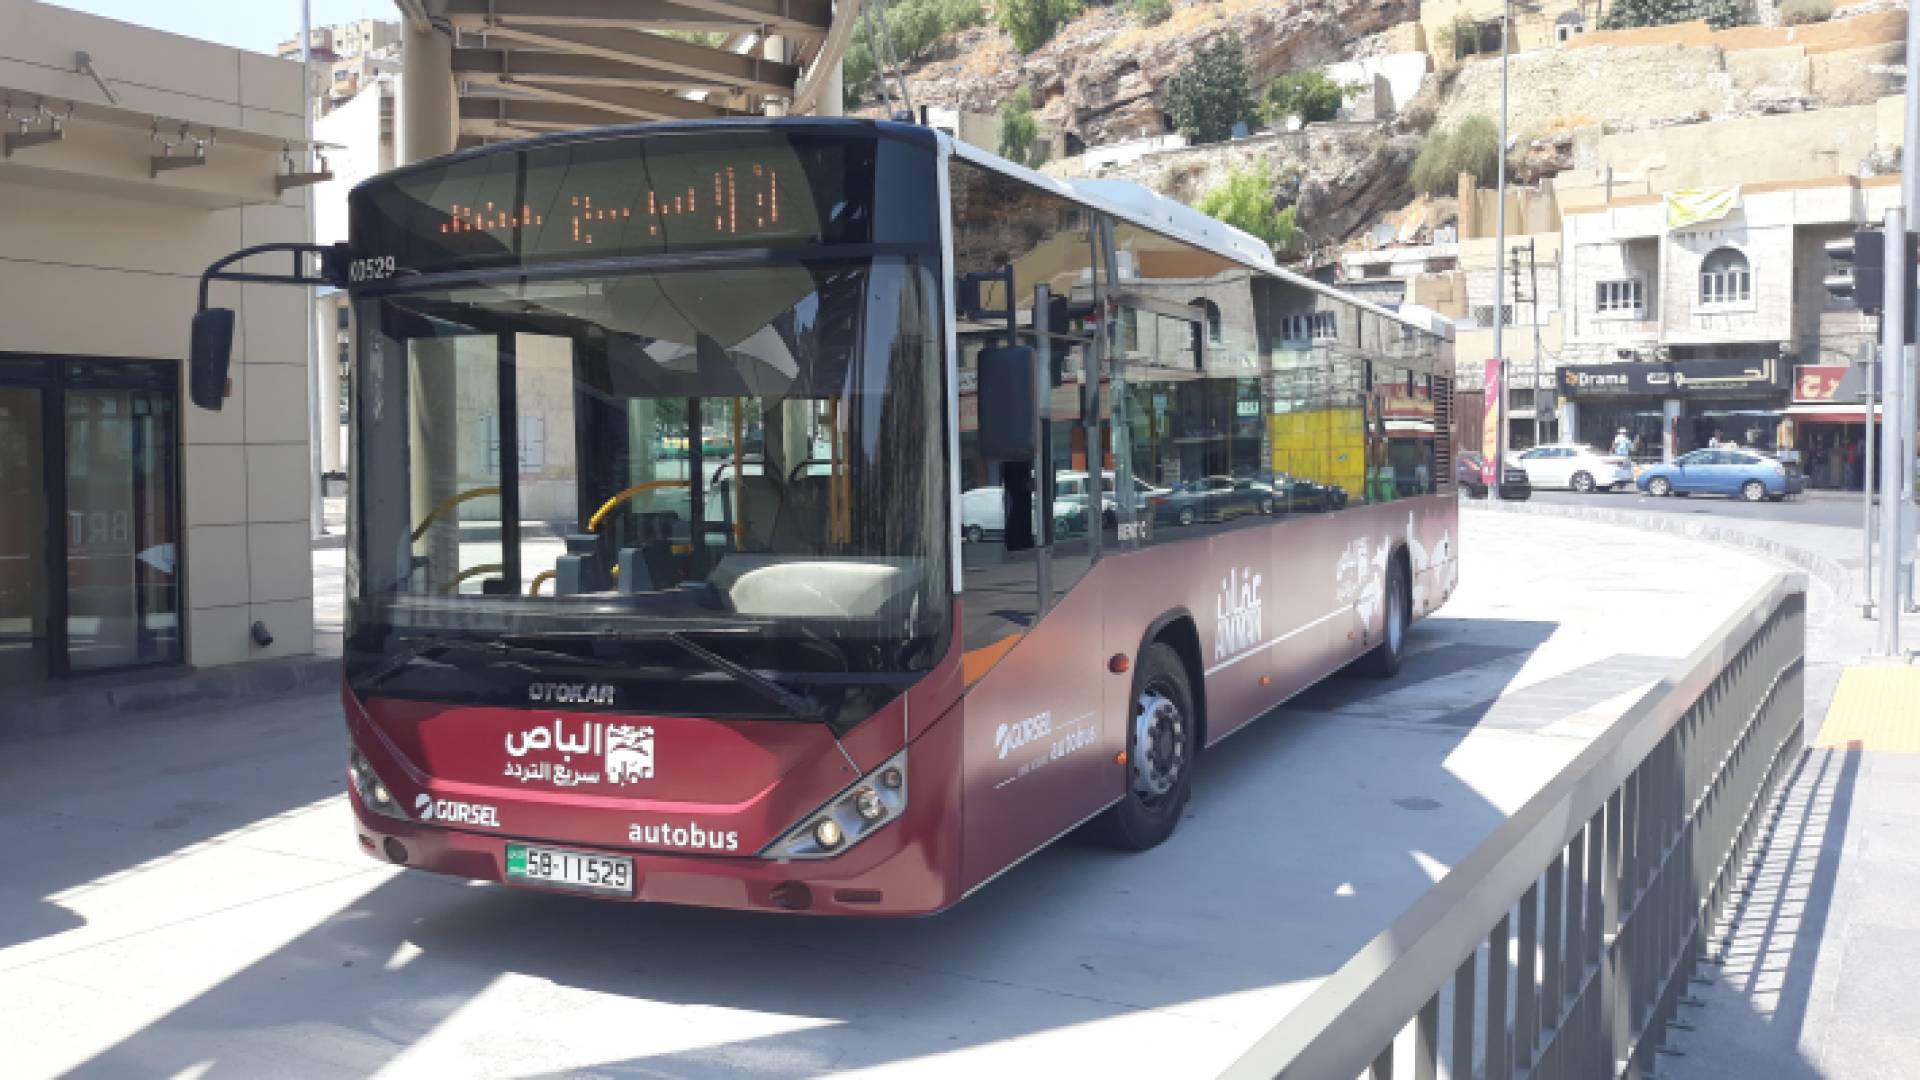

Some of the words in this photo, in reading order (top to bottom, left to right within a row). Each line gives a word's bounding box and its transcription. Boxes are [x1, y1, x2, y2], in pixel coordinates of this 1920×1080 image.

[529, 683, 614, 705] OTOKAR
[505, 718, 602, 762] الباص
[1050, 725, 1096, 760] autobus
[553, 764, 600, 787] سريع
[628, 821, 739, 850] autobus
